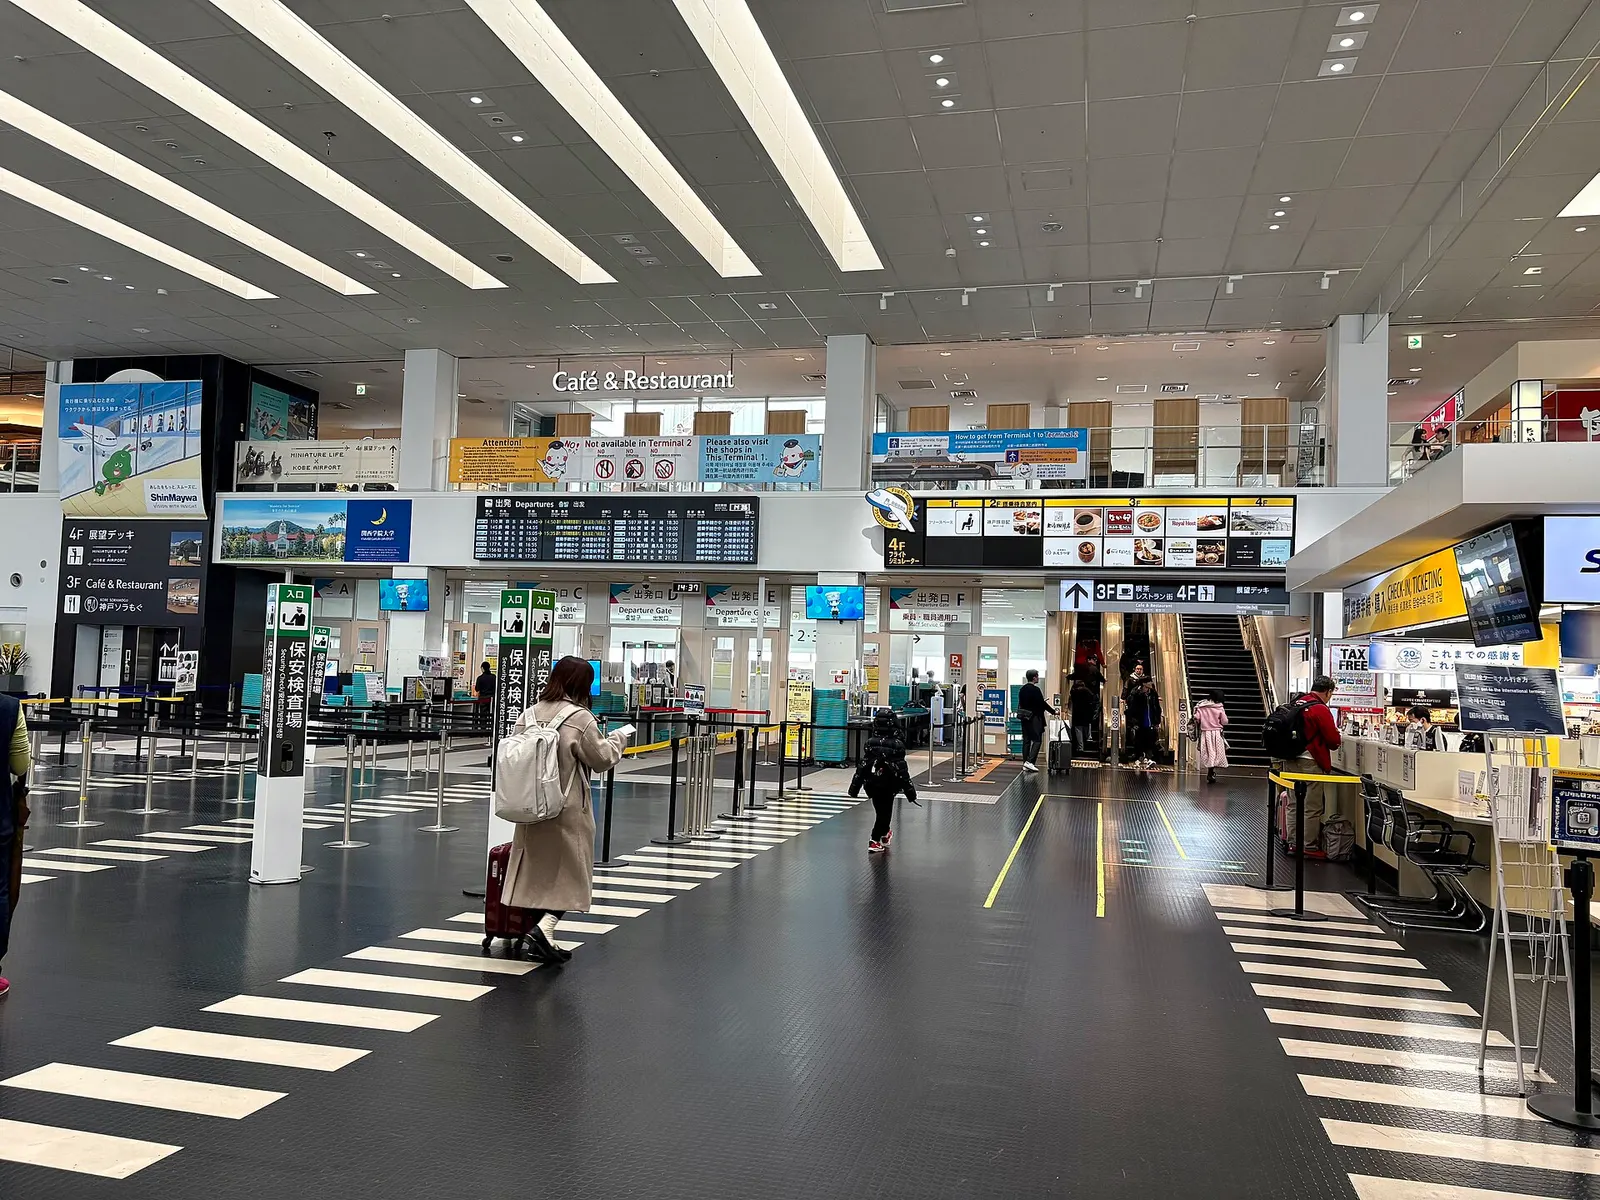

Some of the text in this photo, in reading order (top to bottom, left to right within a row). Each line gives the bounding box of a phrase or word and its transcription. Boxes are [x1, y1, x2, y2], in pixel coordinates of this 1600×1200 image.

[552, 370, 735, 392] Café & Restaurant
[482, 438, 522, 447] Attention!
[564, 440, 580, 449] NO!
[585, 438, 692, 448] Not available in Terminal 2
[706, 438, 769, 447] Please also visit
[706, 446, 752, 456] the shops in
[706, 453, 768, 462] This Terminal 1.
[150, 493, 198, 504] ShinMaywa
[949, 498, 959, 508] 1F
[990, 499, 1001, 508] 2F
[1128, 498, 1141, 507] 3F
[1255, 497, 1268, 507] 4F
[495, 499, 512, 508] 出発
[515, 500, 554, 511] Departures
[69, 527, 135, 541] 4F 展望デッキ
[888, 538, 906, 550] 4F
[66, 575, 163, 590] 3F Café & Restaurant
[1387, 568, 1443, 602] CHECK-IN, TICKETING
[286, 590, 304, 599] 入口
[339, 584, 349, 595] A
[573, 587, 582, 600] C
[634, 589, 663, 600] 出発口
[1096, 584, 1115, 600] 3F
[1176, 585, 1196, 600] 4F
[1236, 586, 1270, 594] 展望デッキ
[507, 595, 522, 604] 入口
[536, 596, 550, 606] 入口
[768, 590, 775, 602] E
[917, 592, 965, 606] 出発口 F
[1136, 593, 1174, 601] レストラン街
[98, 602, 143, 612] 神戸ソラもぐ
[618, 606, 672, 616] Departure Gate
[716, 608, 770, 617] Departure Gte
[902, 613, 958, 622] 乗員・職員通用口
[1340, 648, 1366, 660] TAX
[1430, 649, 1521, 665] これまでの感謝を
[279, 648, 288, 673] Security
[1338, 660, 1368, 671] FREE
[312, 652, 326, 695] 保安検査場
[284, 641, 307, 729] 保安検査場
